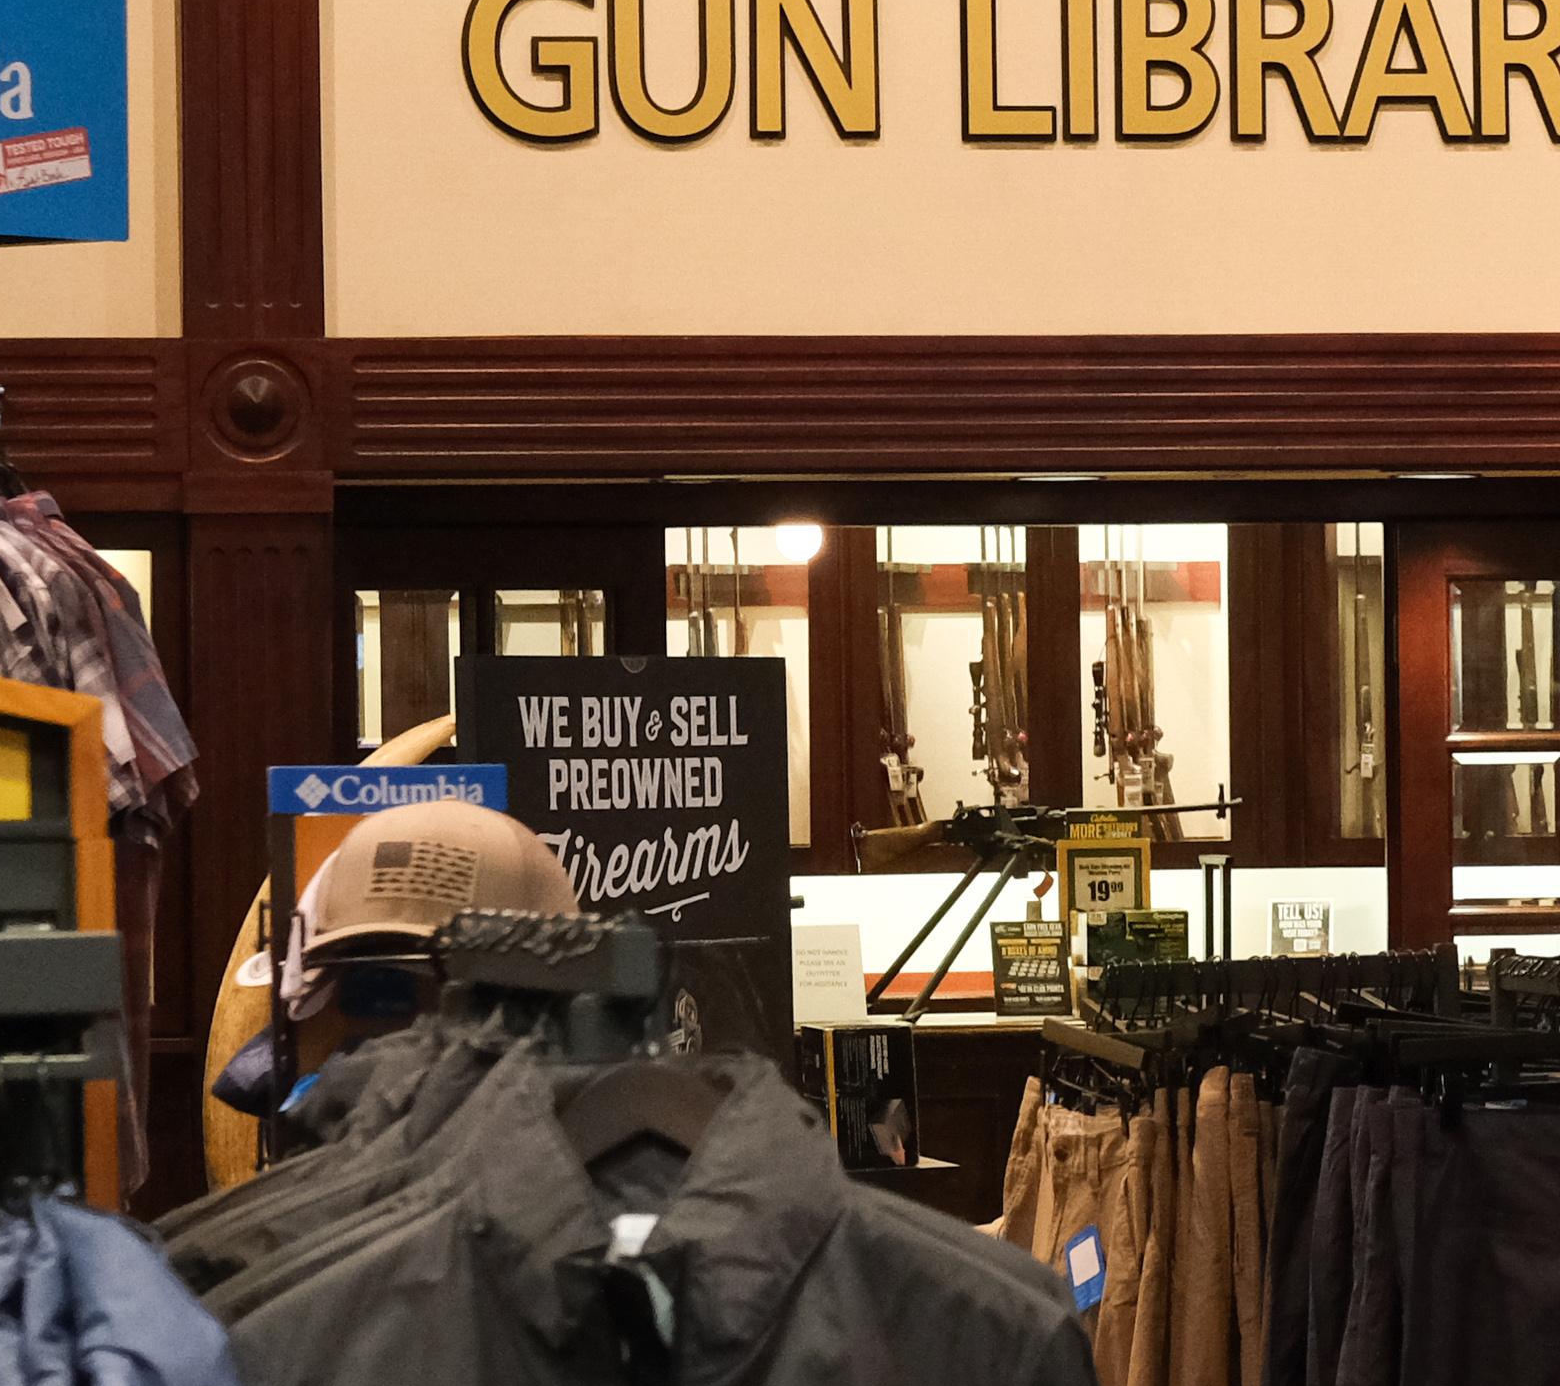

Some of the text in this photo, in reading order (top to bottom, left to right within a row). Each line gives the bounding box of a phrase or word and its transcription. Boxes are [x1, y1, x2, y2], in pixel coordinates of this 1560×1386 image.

[517, 694, 748, 748] WE BUY & SELL
[331, 773, 485, 806] Columbia
[548, 756, 723, 811] PREOWNED
[1069, 823, 1103, 840] MORE
[1277, 903, 1324, 920] TELL US!
